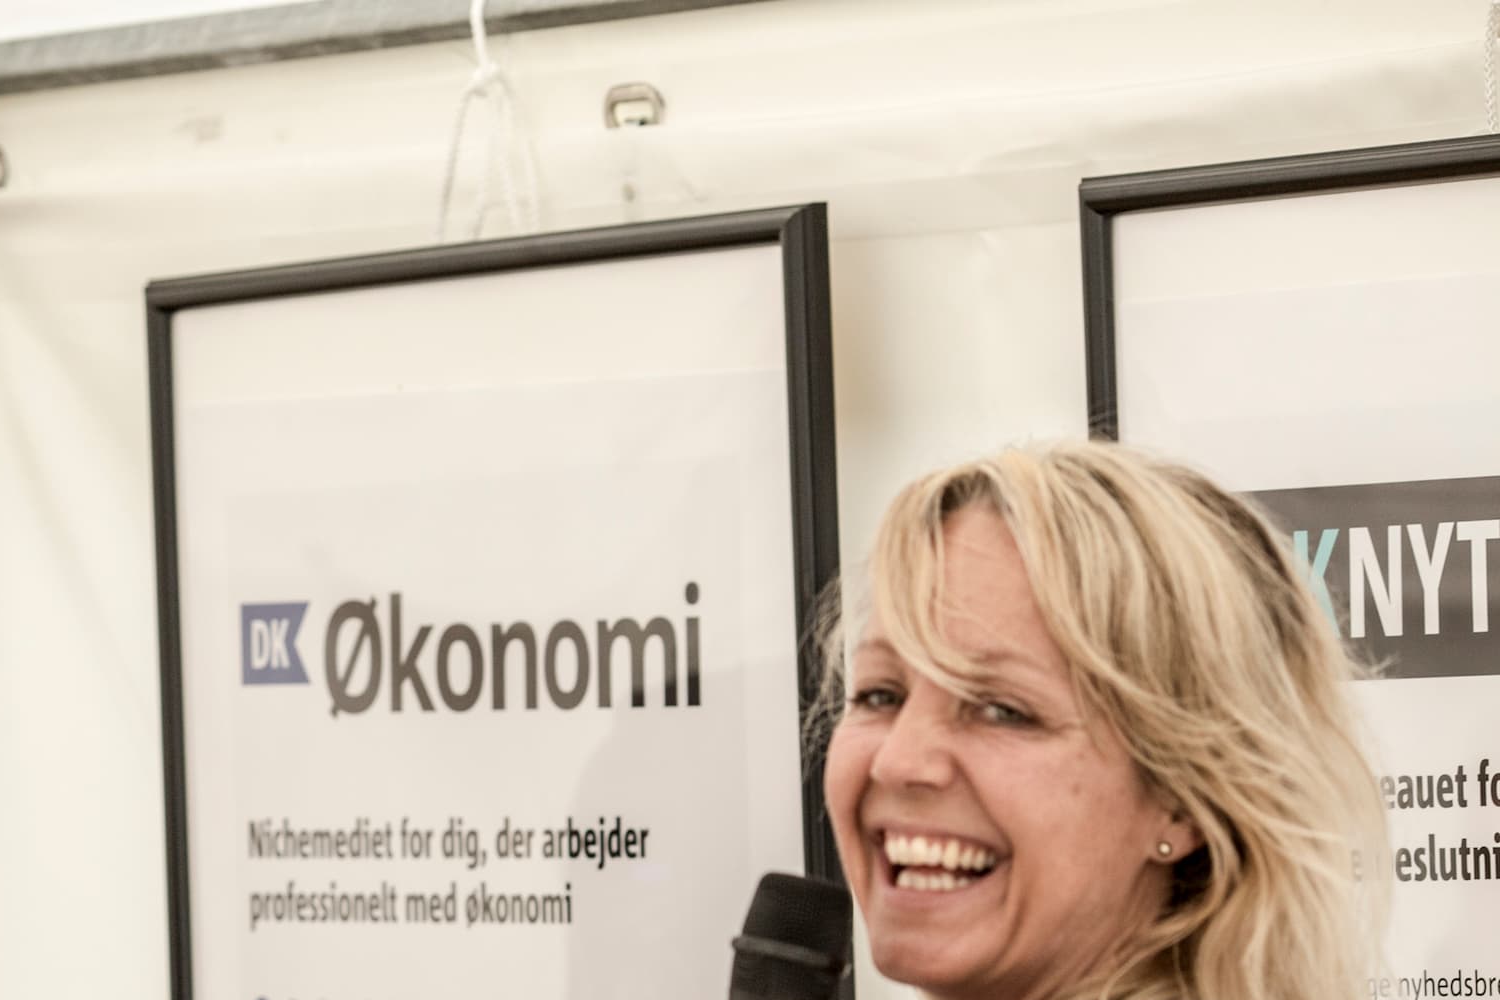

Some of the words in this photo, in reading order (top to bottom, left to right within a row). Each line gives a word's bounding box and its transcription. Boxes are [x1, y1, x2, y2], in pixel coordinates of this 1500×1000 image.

[250, 618, 290, 671] DK
[324, 581, 701, 719] Økonomi
[1380, 765, 1468, 810] eauet
[248, 818, 393, 860] Nichemediet
[400, 818, 433, 860] for
[442, 819, 487, 868] dig,
[496, 819, 533, 860] der
[543, 816, 650, 870] arbejder
[1396, 833, 1500, 882] eslutni
[249, 882, 397, 931] professionelt
[405, 882, 456, 925] med
[466, 882, 572, 929] økonomi
